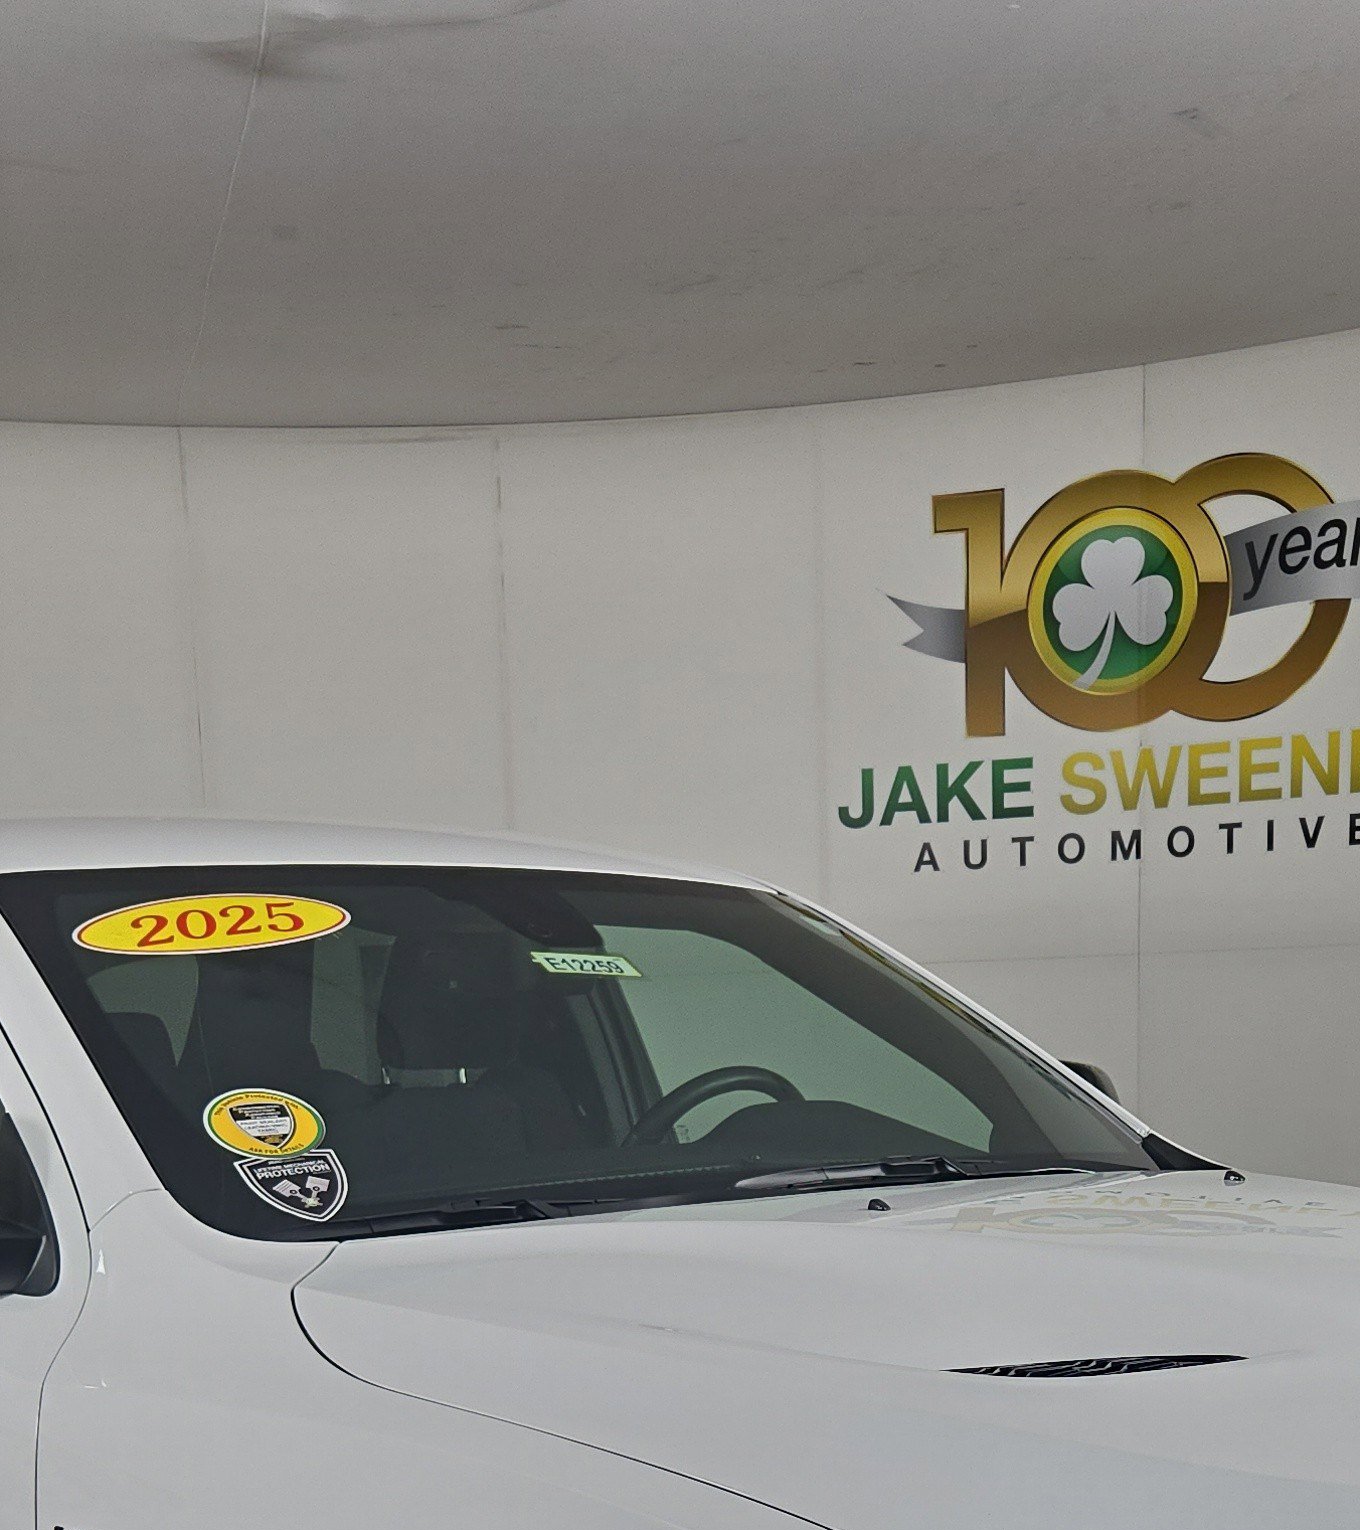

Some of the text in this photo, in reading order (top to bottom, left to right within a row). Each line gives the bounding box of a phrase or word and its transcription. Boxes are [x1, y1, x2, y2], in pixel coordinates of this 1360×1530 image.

[931, 452, 1351, 738] 100
[838, 757, 1035, 829] JAKE
[131, 902, 305, 948] 2025
[543, 957, 624, 974] E12259
[255, 1163, 331, 1181] PROTECTION
